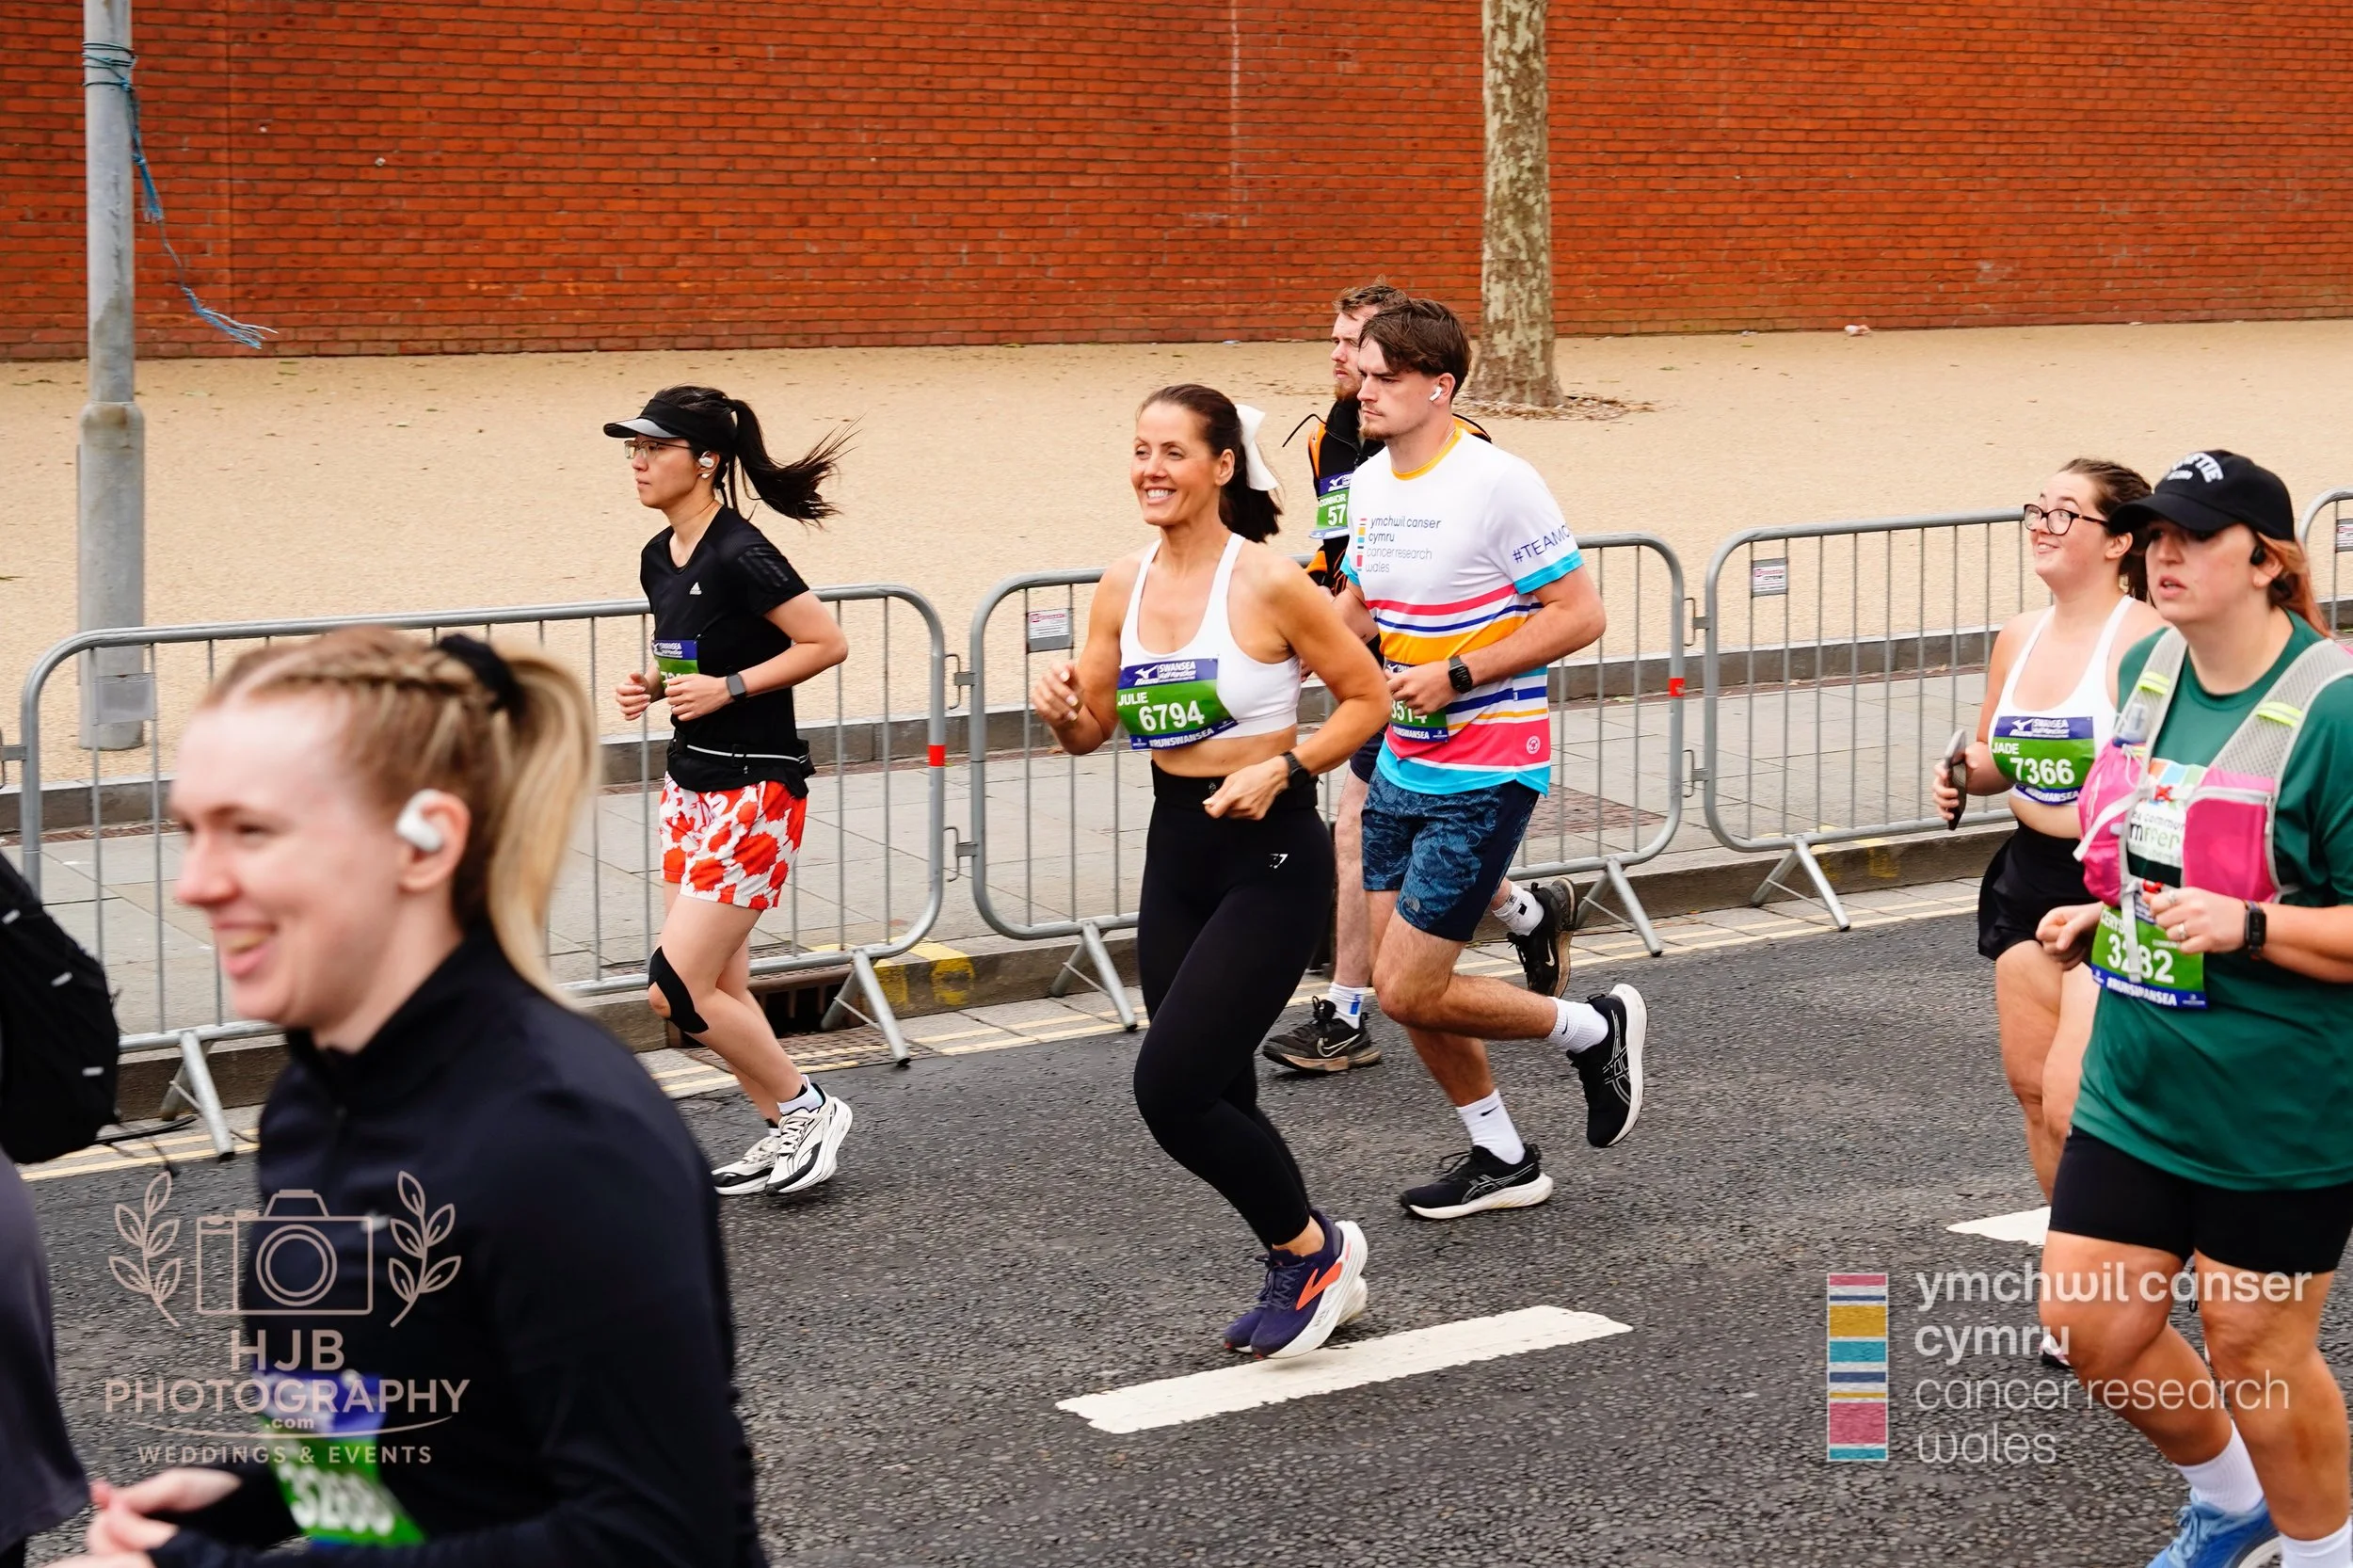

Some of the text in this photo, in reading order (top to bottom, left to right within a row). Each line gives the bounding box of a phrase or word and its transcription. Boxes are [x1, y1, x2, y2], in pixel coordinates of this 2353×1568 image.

[1370, 515, 1441, 529] ymchwil canser
[1369, 532, 1395, 544] cymru
[1366, 547, 1433, 560] cancer research
[1365, 561, 1390, 573] wales
[1159, 661, 1196, 673] SWANSEA
[1118, 691, 1149, 707] JULIE
[1138, 699, 1205, 732] 6794
[1992, 742, 2020, 755] JADE
[2009, 757, 2075, 786] 7366
